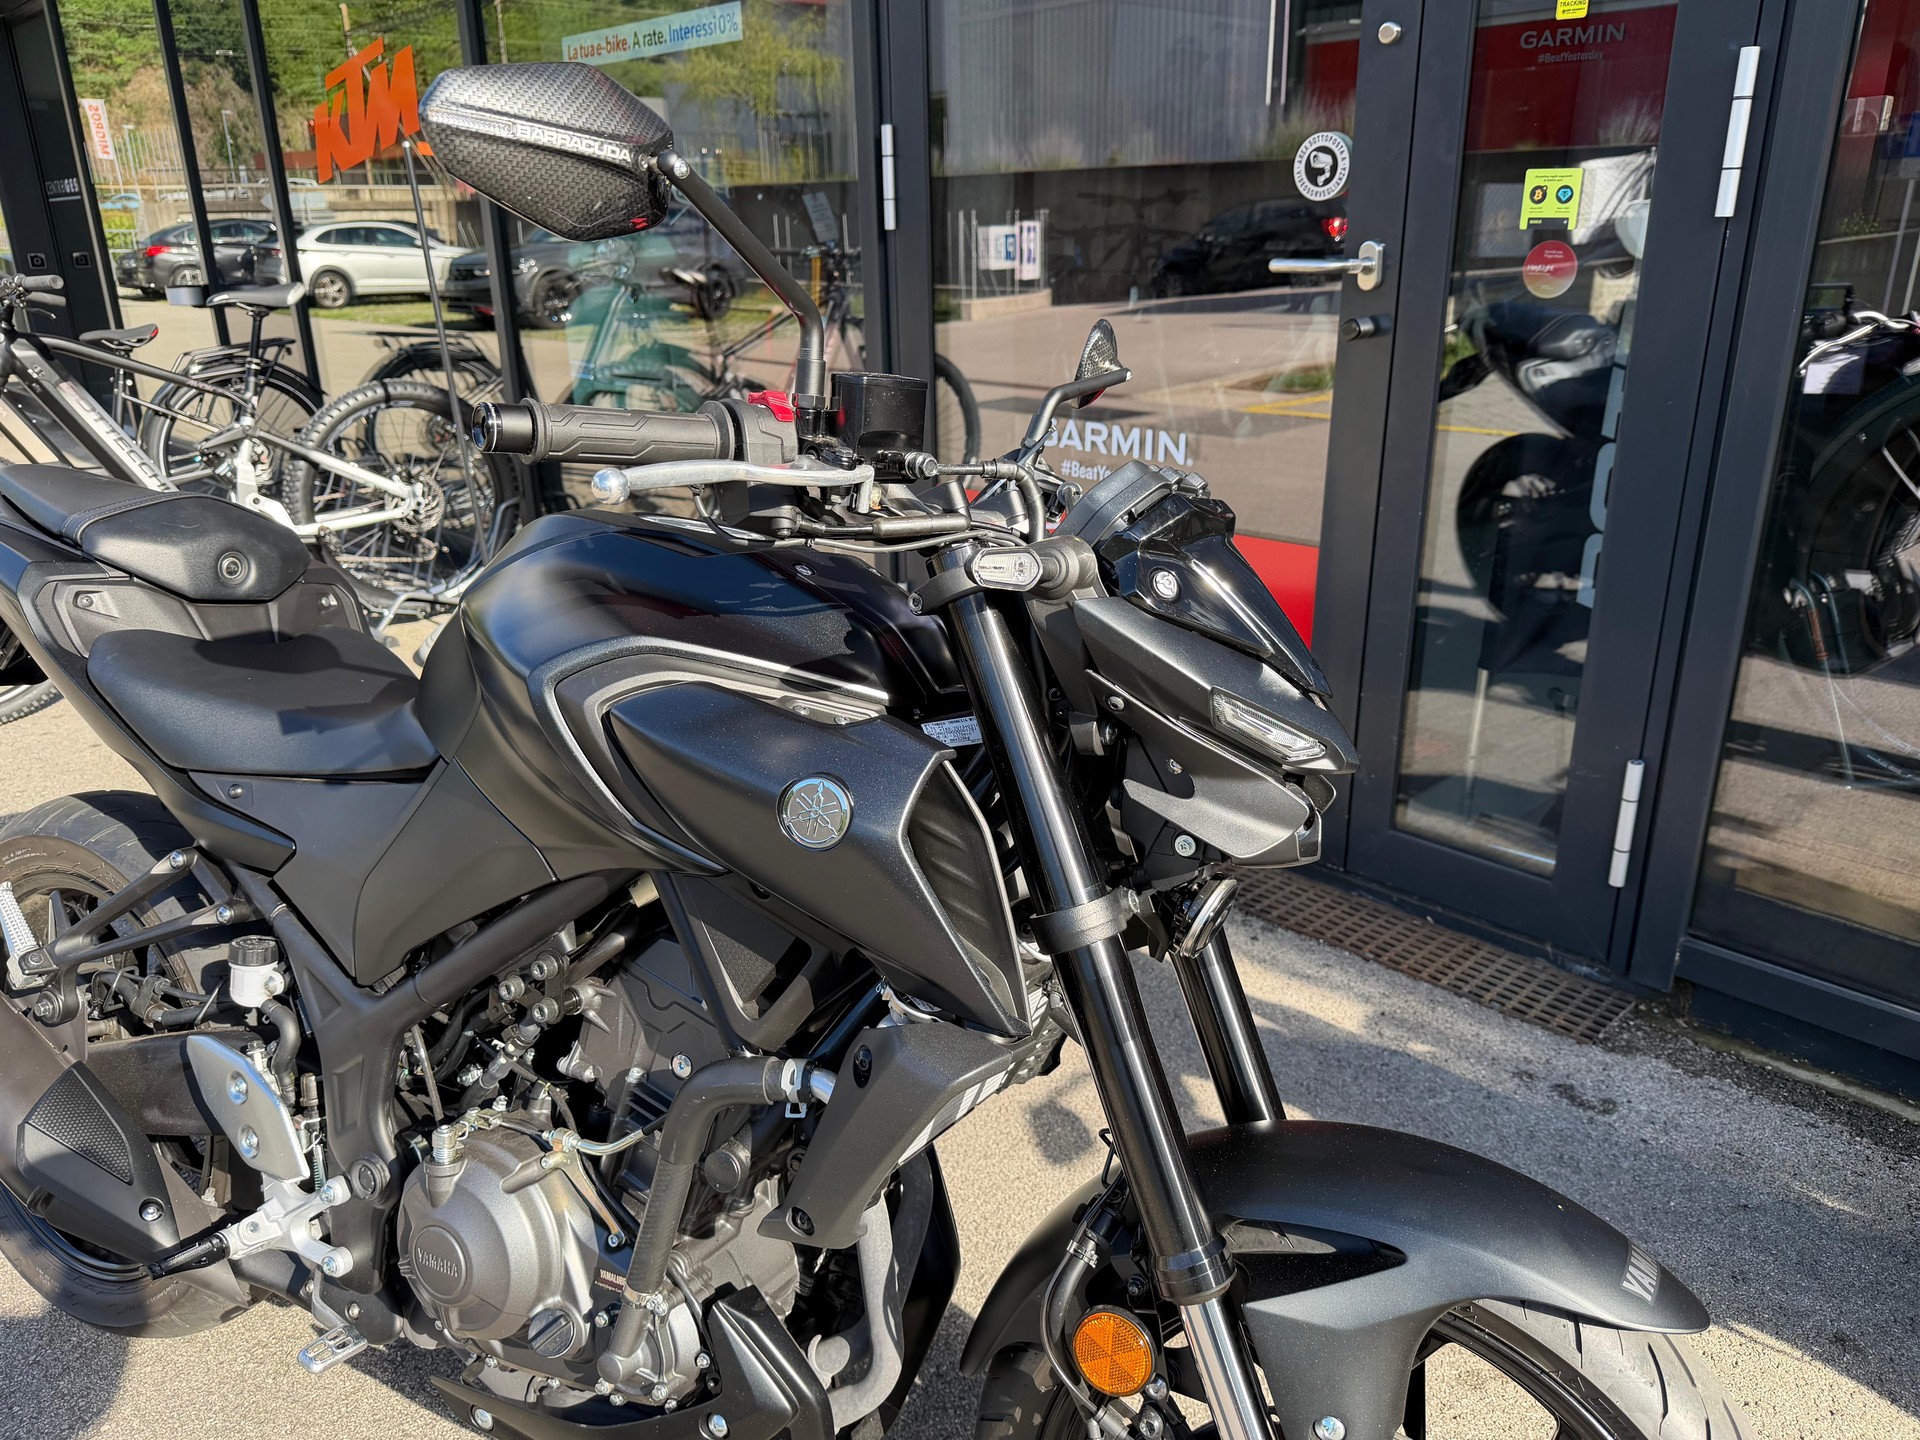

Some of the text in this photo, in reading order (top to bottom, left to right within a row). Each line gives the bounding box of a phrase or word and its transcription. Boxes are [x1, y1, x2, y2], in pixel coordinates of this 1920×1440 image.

[567, 45, 579, 61] La
[632, 32, 641, 49] A
[642, 30, 667, 47] rate.
[668, 16, 717, 42] Interessi
[718, 12, 738, 34] 0%
[1520, 22, 1625, 48] GARMIN
[1537, 50, 1604, 63] #BeatYesterday
[313, 36, 420, 184] KTM
[516, 124, 631, 162] BARRACUDA
[1060, 459, 1112, 481] #BeatYe
[417, 1247, 458, 1277] YAMAHA
